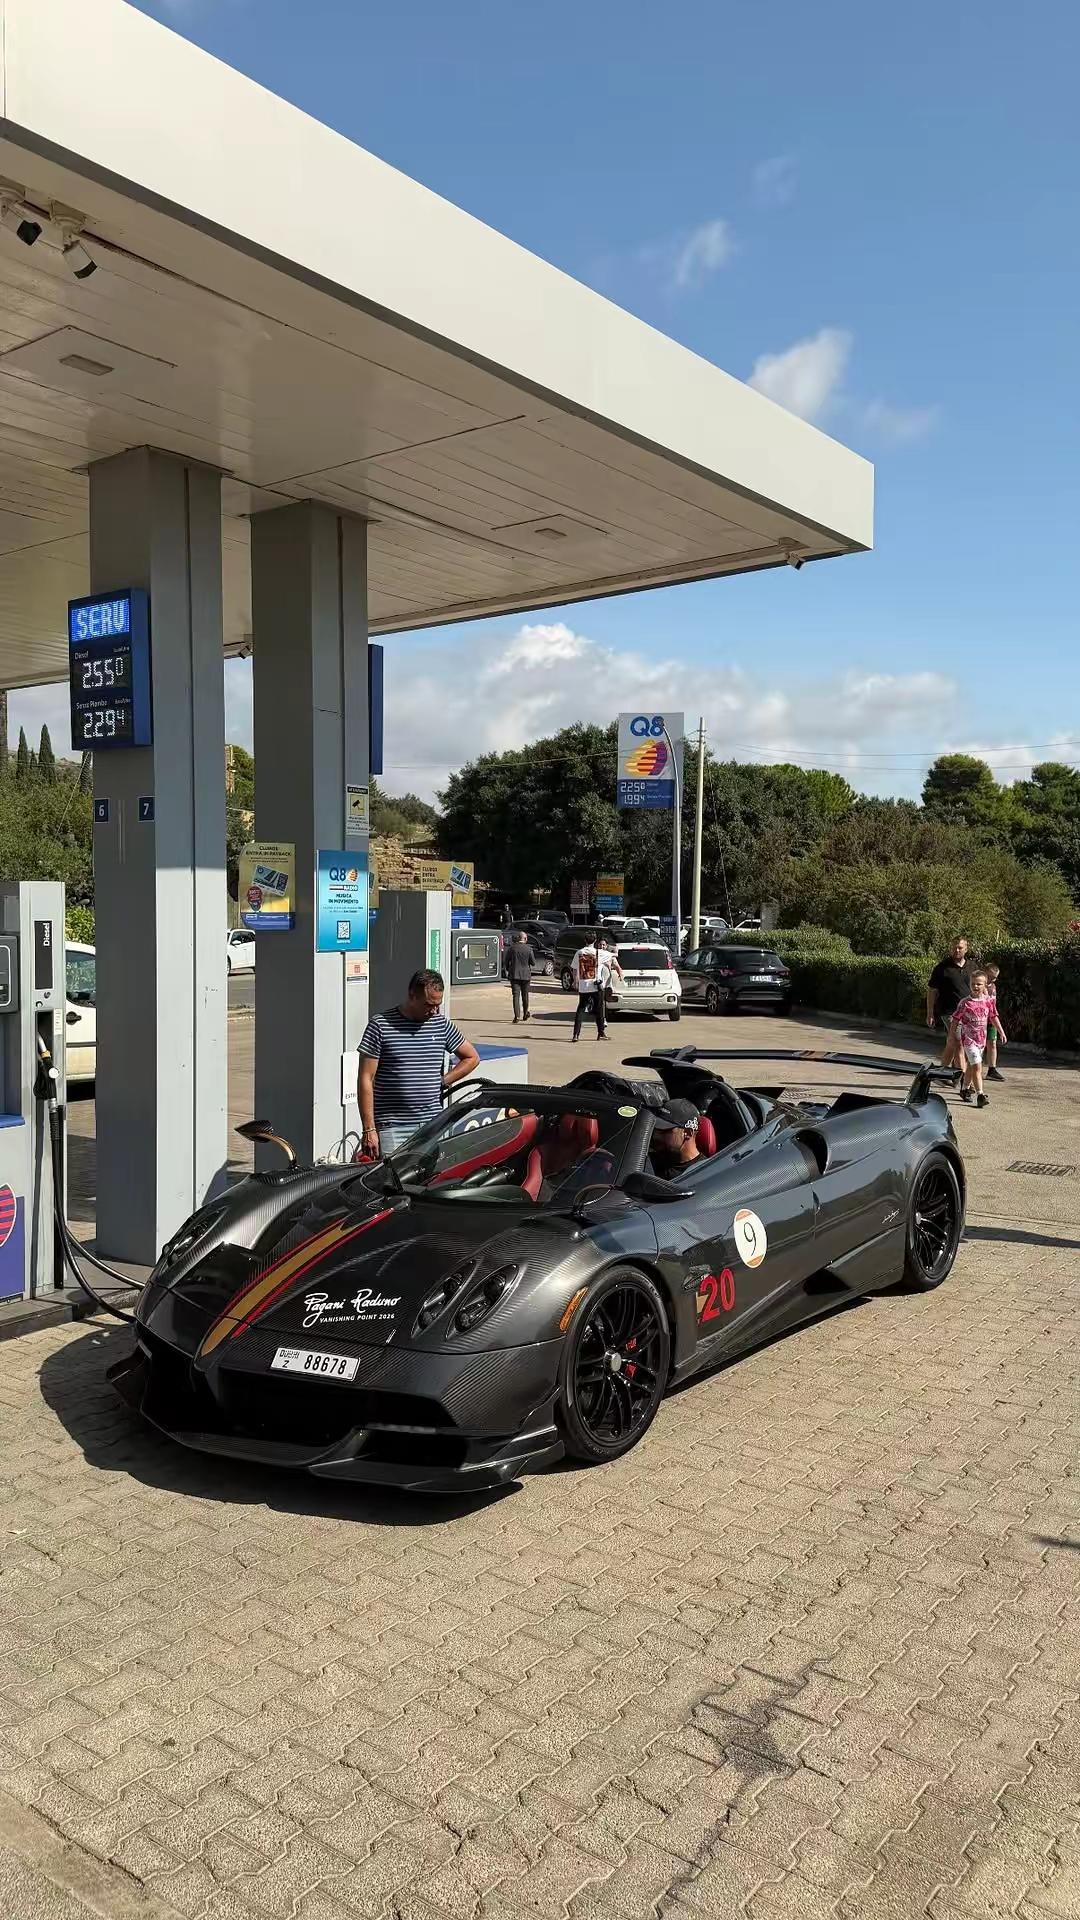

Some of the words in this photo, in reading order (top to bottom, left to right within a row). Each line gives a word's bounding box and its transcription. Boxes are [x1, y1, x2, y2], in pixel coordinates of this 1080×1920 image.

[74, 651, 89, 660] Diesel
[630, 716, 665, 736] Q8
[98, 804, 105, 816] 6
[143, 803, 149, 815] 7
[329, 867, 346, 881] Q8
[461, 944, 468, 959] 1
[743, 1222, 757, 1257] 9
[700, 1268, 735, 1322] 20
[302, 1292, 346, 1328] Pagani
[350, 1288, 402, 1313] Raduno
[320, 1315, 355, 1323] VANISHING
[282, 1360, 290, 1368] Z
[304, 1354, 347, 1375] 88678
